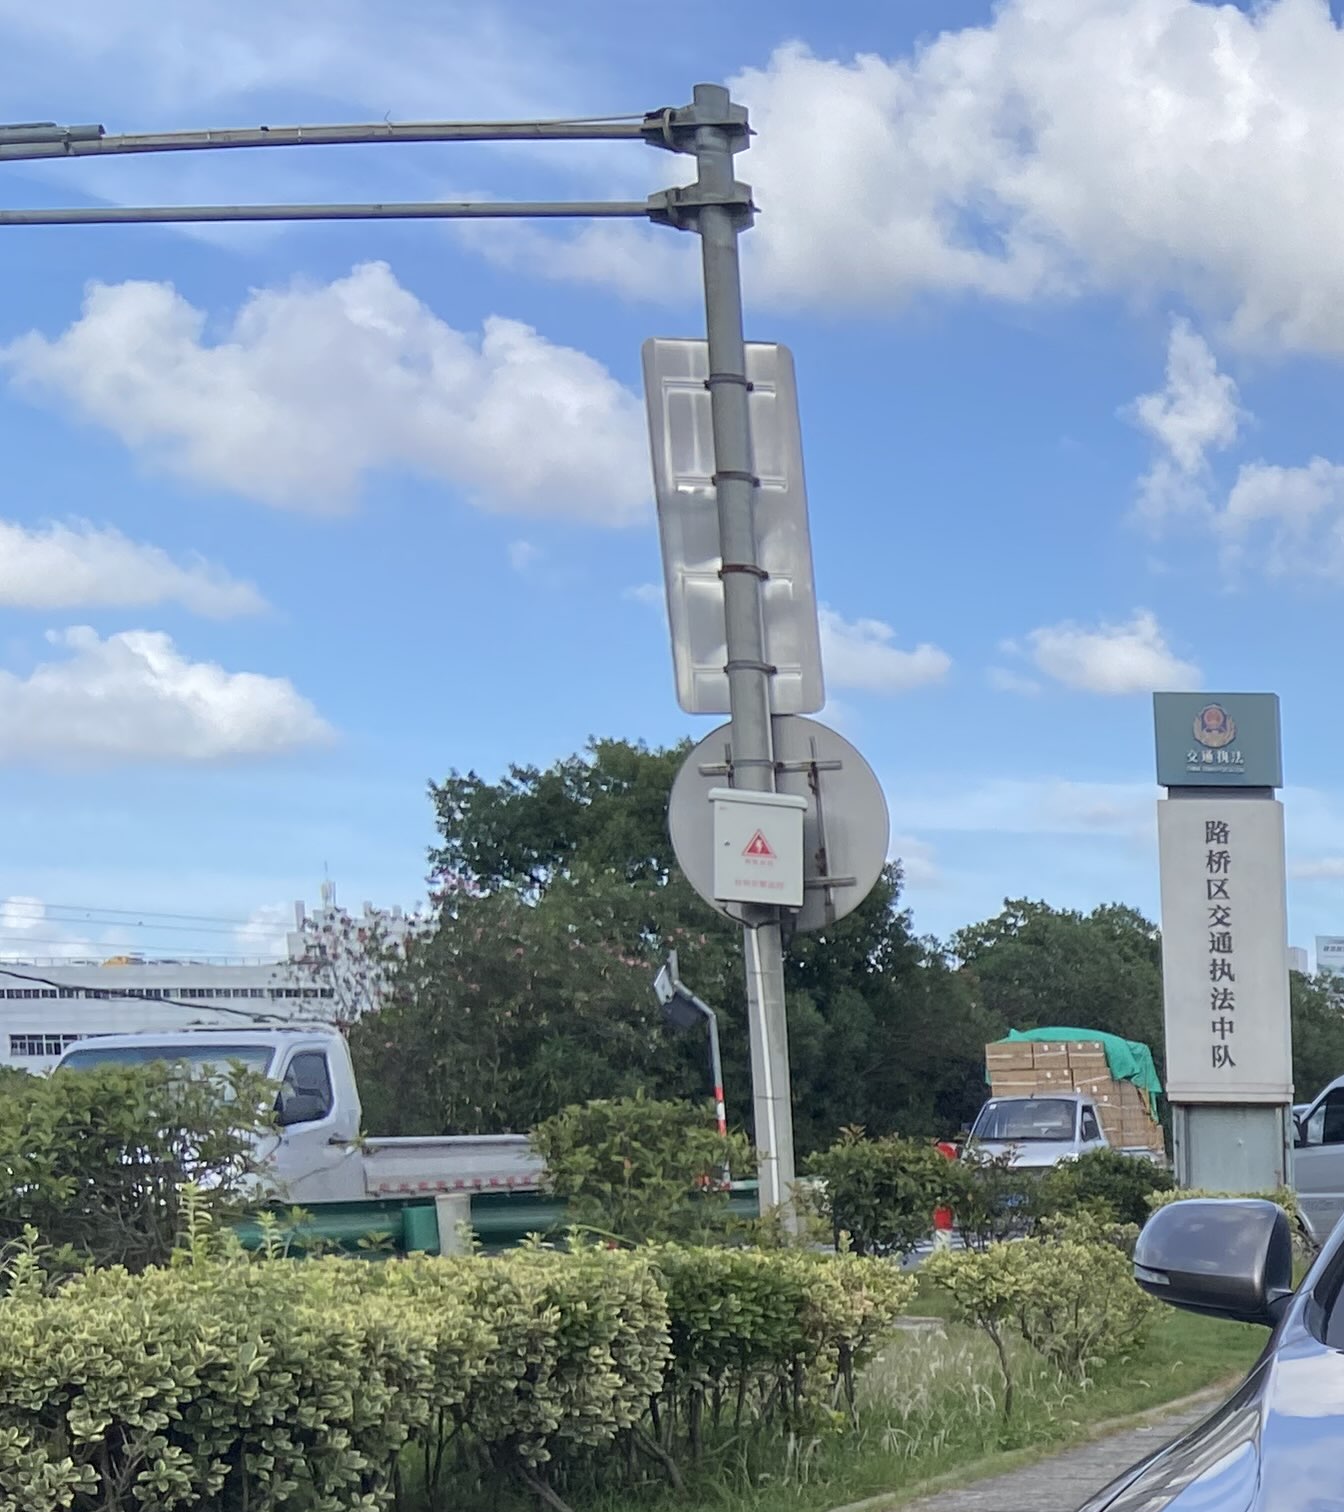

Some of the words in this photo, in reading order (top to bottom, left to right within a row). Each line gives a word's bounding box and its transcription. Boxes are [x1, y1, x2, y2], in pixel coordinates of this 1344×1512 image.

[1187, 749, 1244, 764] 交通执法
[1205, 820, 1236, 1069] 路桥区交通执法中队
